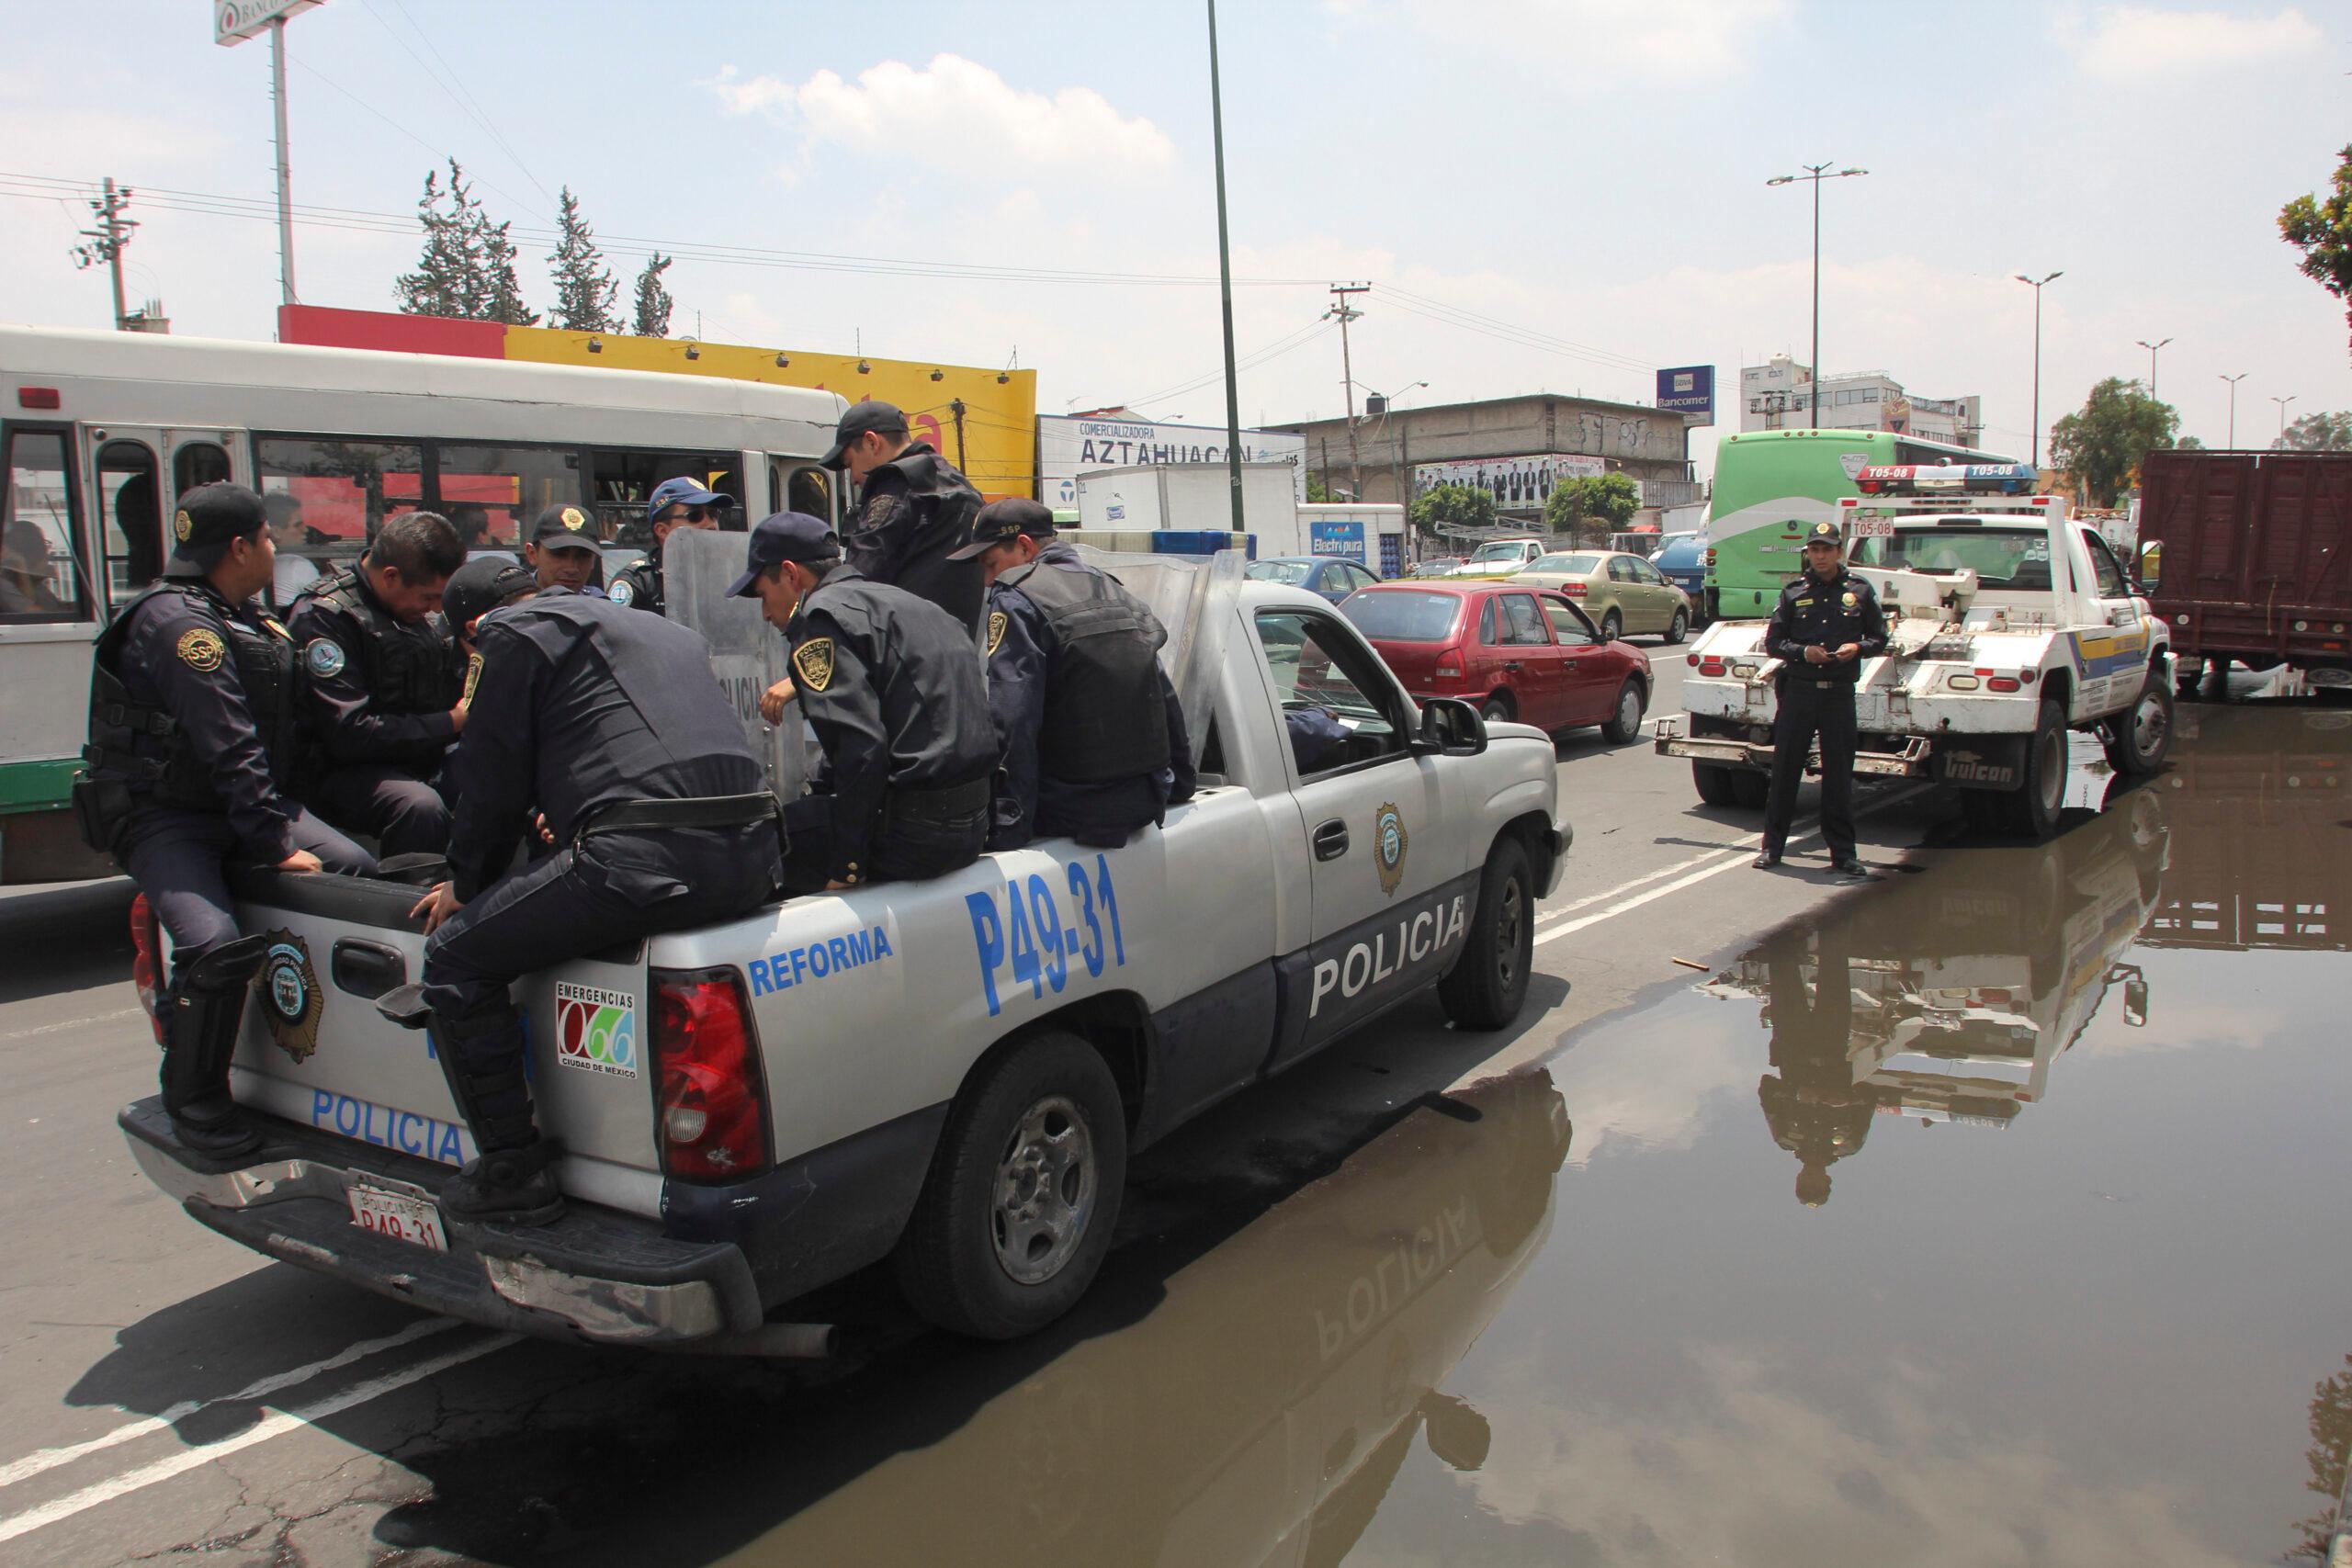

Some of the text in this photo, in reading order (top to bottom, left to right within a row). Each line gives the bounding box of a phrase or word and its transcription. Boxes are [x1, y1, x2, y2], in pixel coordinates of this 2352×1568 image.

[1657, 396, 1709, 408] Bancomer
[1080, 423, 1155, 440] COMERCIALIZADORA
[1869, 468, 1908, 478] T05-08
[1971, 464, 2014, 476] T05-08
[1001, 525, 1021, 536] SSP
[1853, 523, 1891, 535] T05-08
[189, 645, 213, 660] SSP
[718, 676, 762, 722] OLICIA
[965, 853, 1125, 1017] P49-31
[749, 925, 893, 997] REFORMA
[1308, 895, 1465, 1019] POLICIA
[558, 984, 633, 1009] EMERGENCIAS
[559, 1001, 633, 1066] 066
[562, 1057, 591, 1069] CIUDAD
[593, 1064, 604, 1072] DE
[311, 1089, 465, 1168] POLICIA
